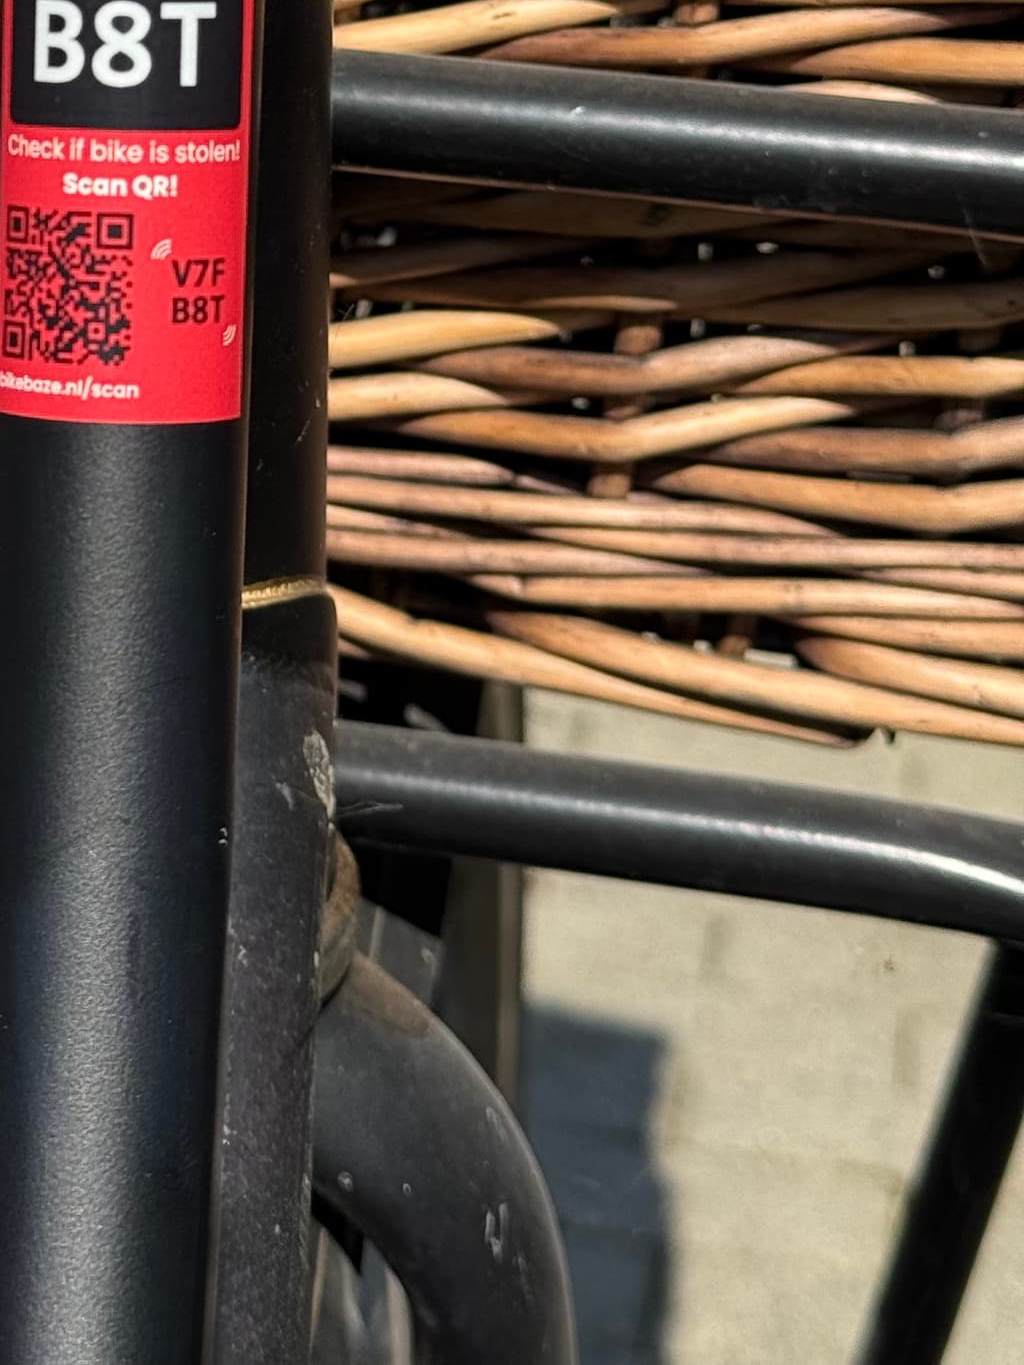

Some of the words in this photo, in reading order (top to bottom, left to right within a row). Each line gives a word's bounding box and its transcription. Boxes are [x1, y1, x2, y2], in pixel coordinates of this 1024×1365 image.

[8, 134, 65, 161] Check
[69, 137, 85, 161] if
[90, 139, 143, 163] bike
[149, 141, 169, 163] is
[175, 140, 240, 163] stolen!
[62, 172, 127, 196] Scan
[132, 175, 178, 200] QR!
[172, 257, 225, 287] V7F
[172, 294, 225, 324] B8T
